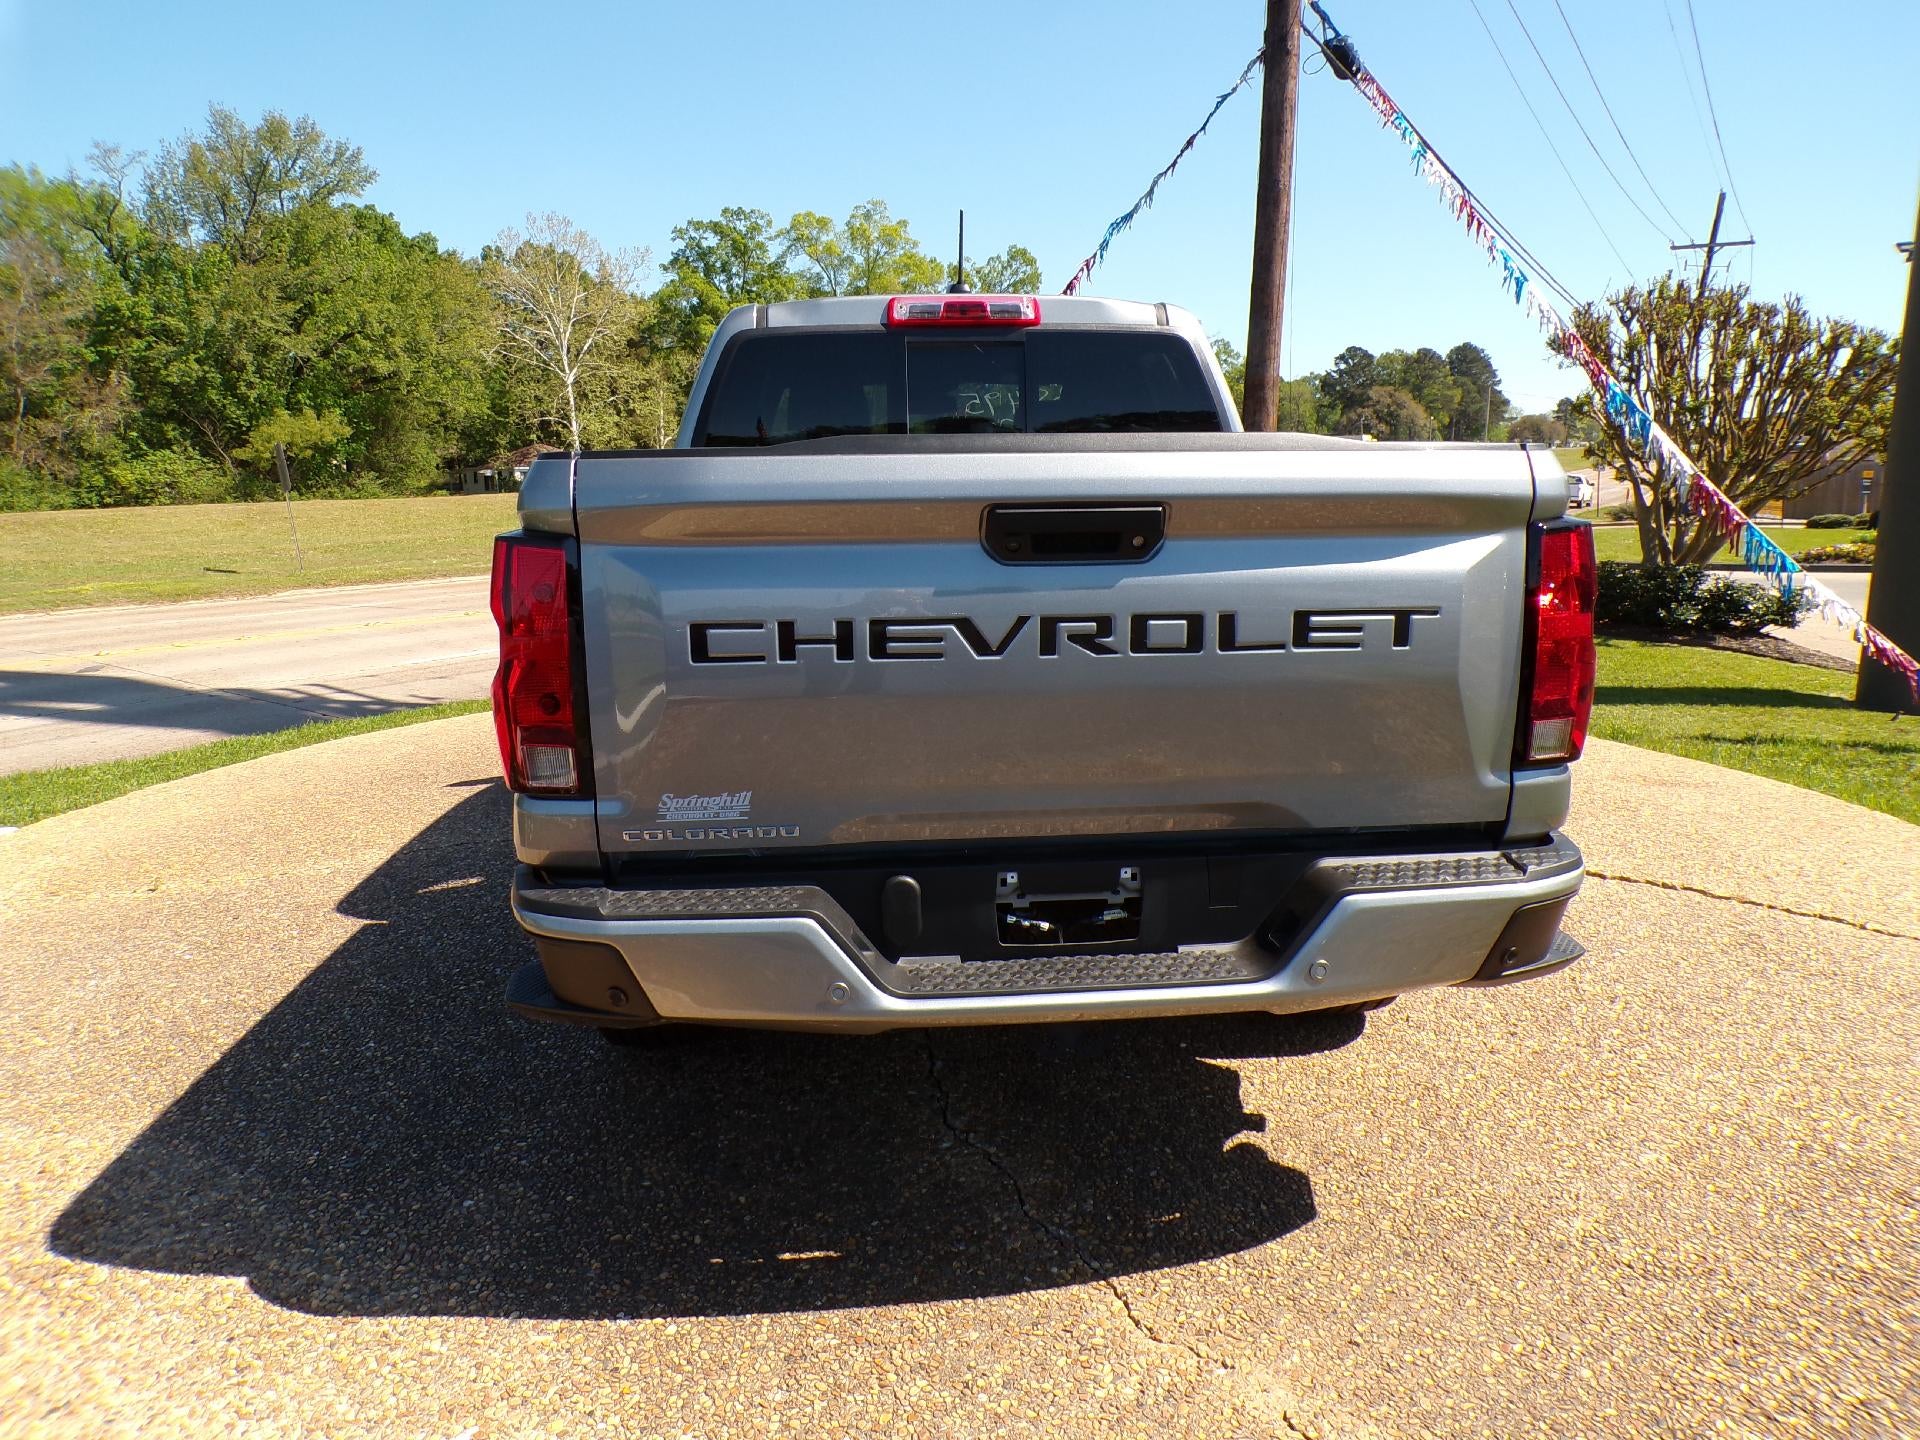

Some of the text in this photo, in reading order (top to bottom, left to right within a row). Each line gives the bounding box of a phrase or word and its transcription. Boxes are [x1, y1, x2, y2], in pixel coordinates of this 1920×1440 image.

[688, 606, 1441, 665] CHEVROLET
[658, 791, 752, 811] Springhill
[622, 824, 800, 841] COLORADO
